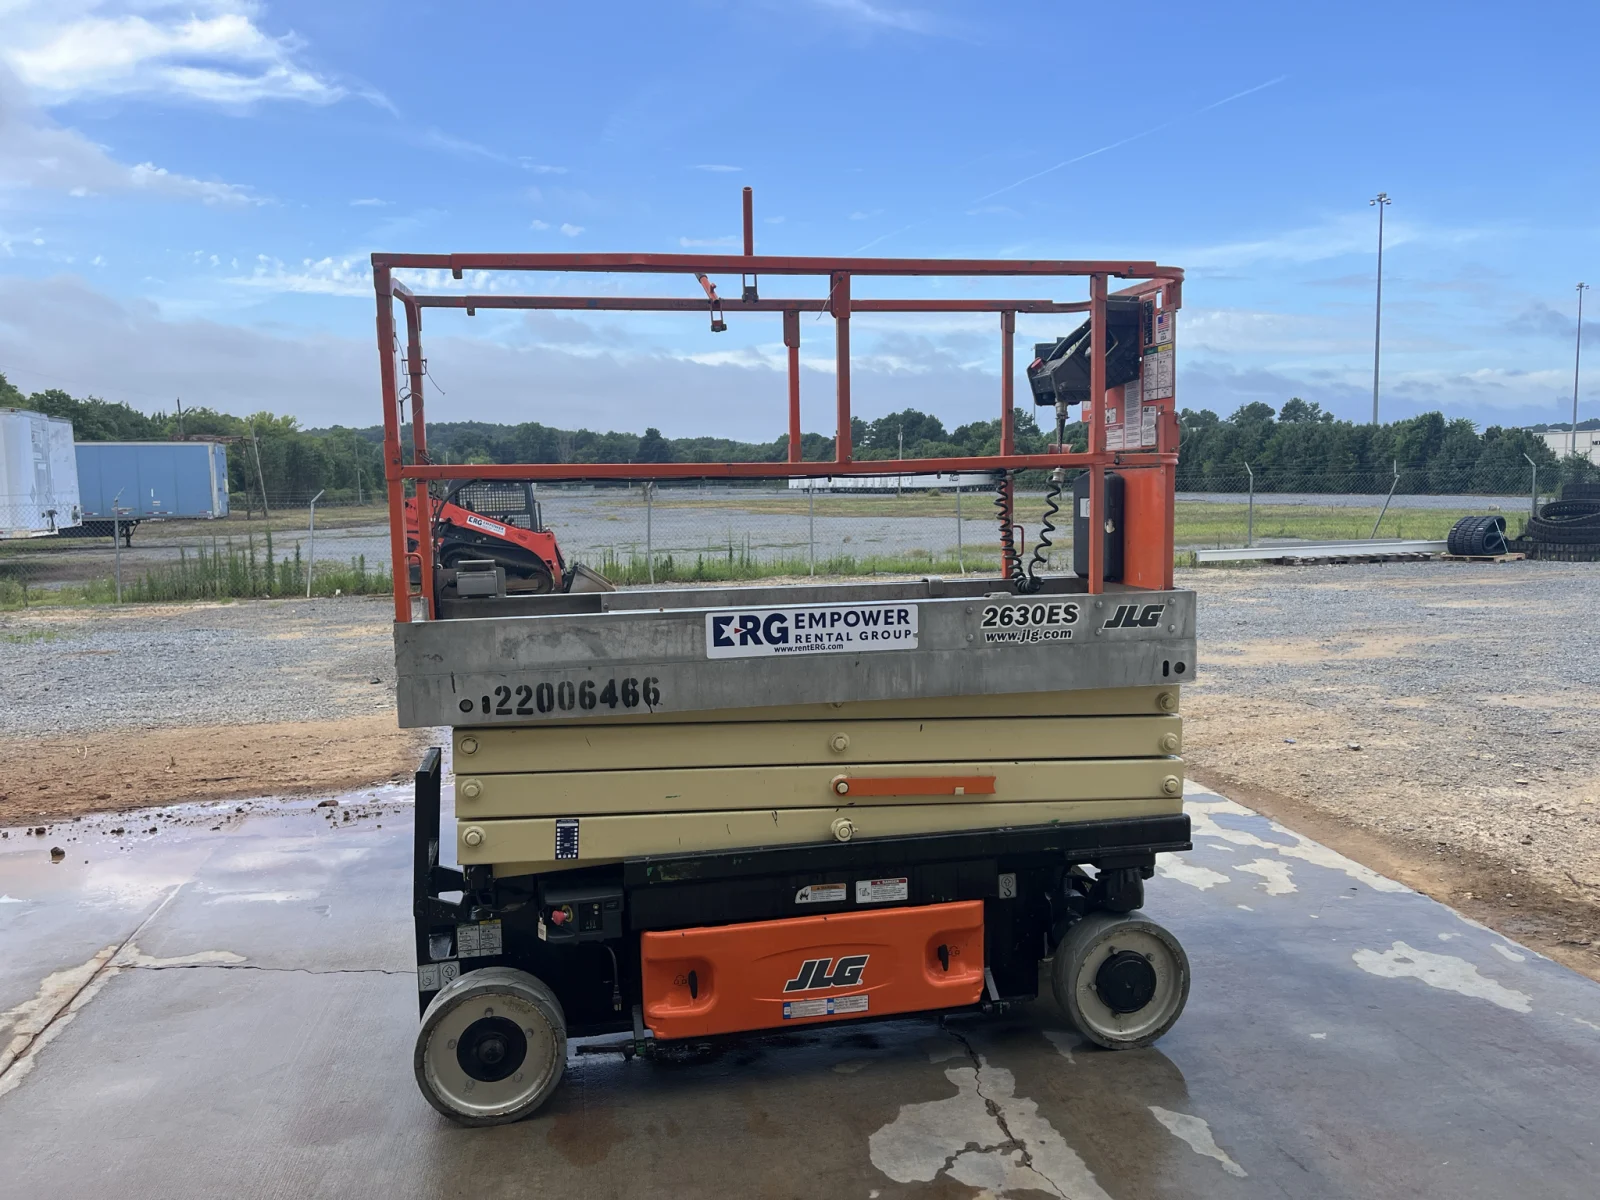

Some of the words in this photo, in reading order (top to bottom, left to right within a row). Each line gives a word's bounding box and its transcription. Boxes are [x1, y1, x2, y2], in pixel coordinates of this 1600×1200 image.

[794, 608, 910, 630] EMPOWER
[981, 603, 1080, 628] 2630ES
[1102, 604, 1166, 630] JLG
[712, 613, 789, 647] ERG
[795, 631, 853, 644] RENTAL
[859, 629, 912, 641] GROUP
[985, 628, 1073, 643] www.jlg.com
[774, 643, 844, 653] www.rentERG.com
[494, 677, 661, 715] 22006466
[783, 954, 870, 993] JLG
